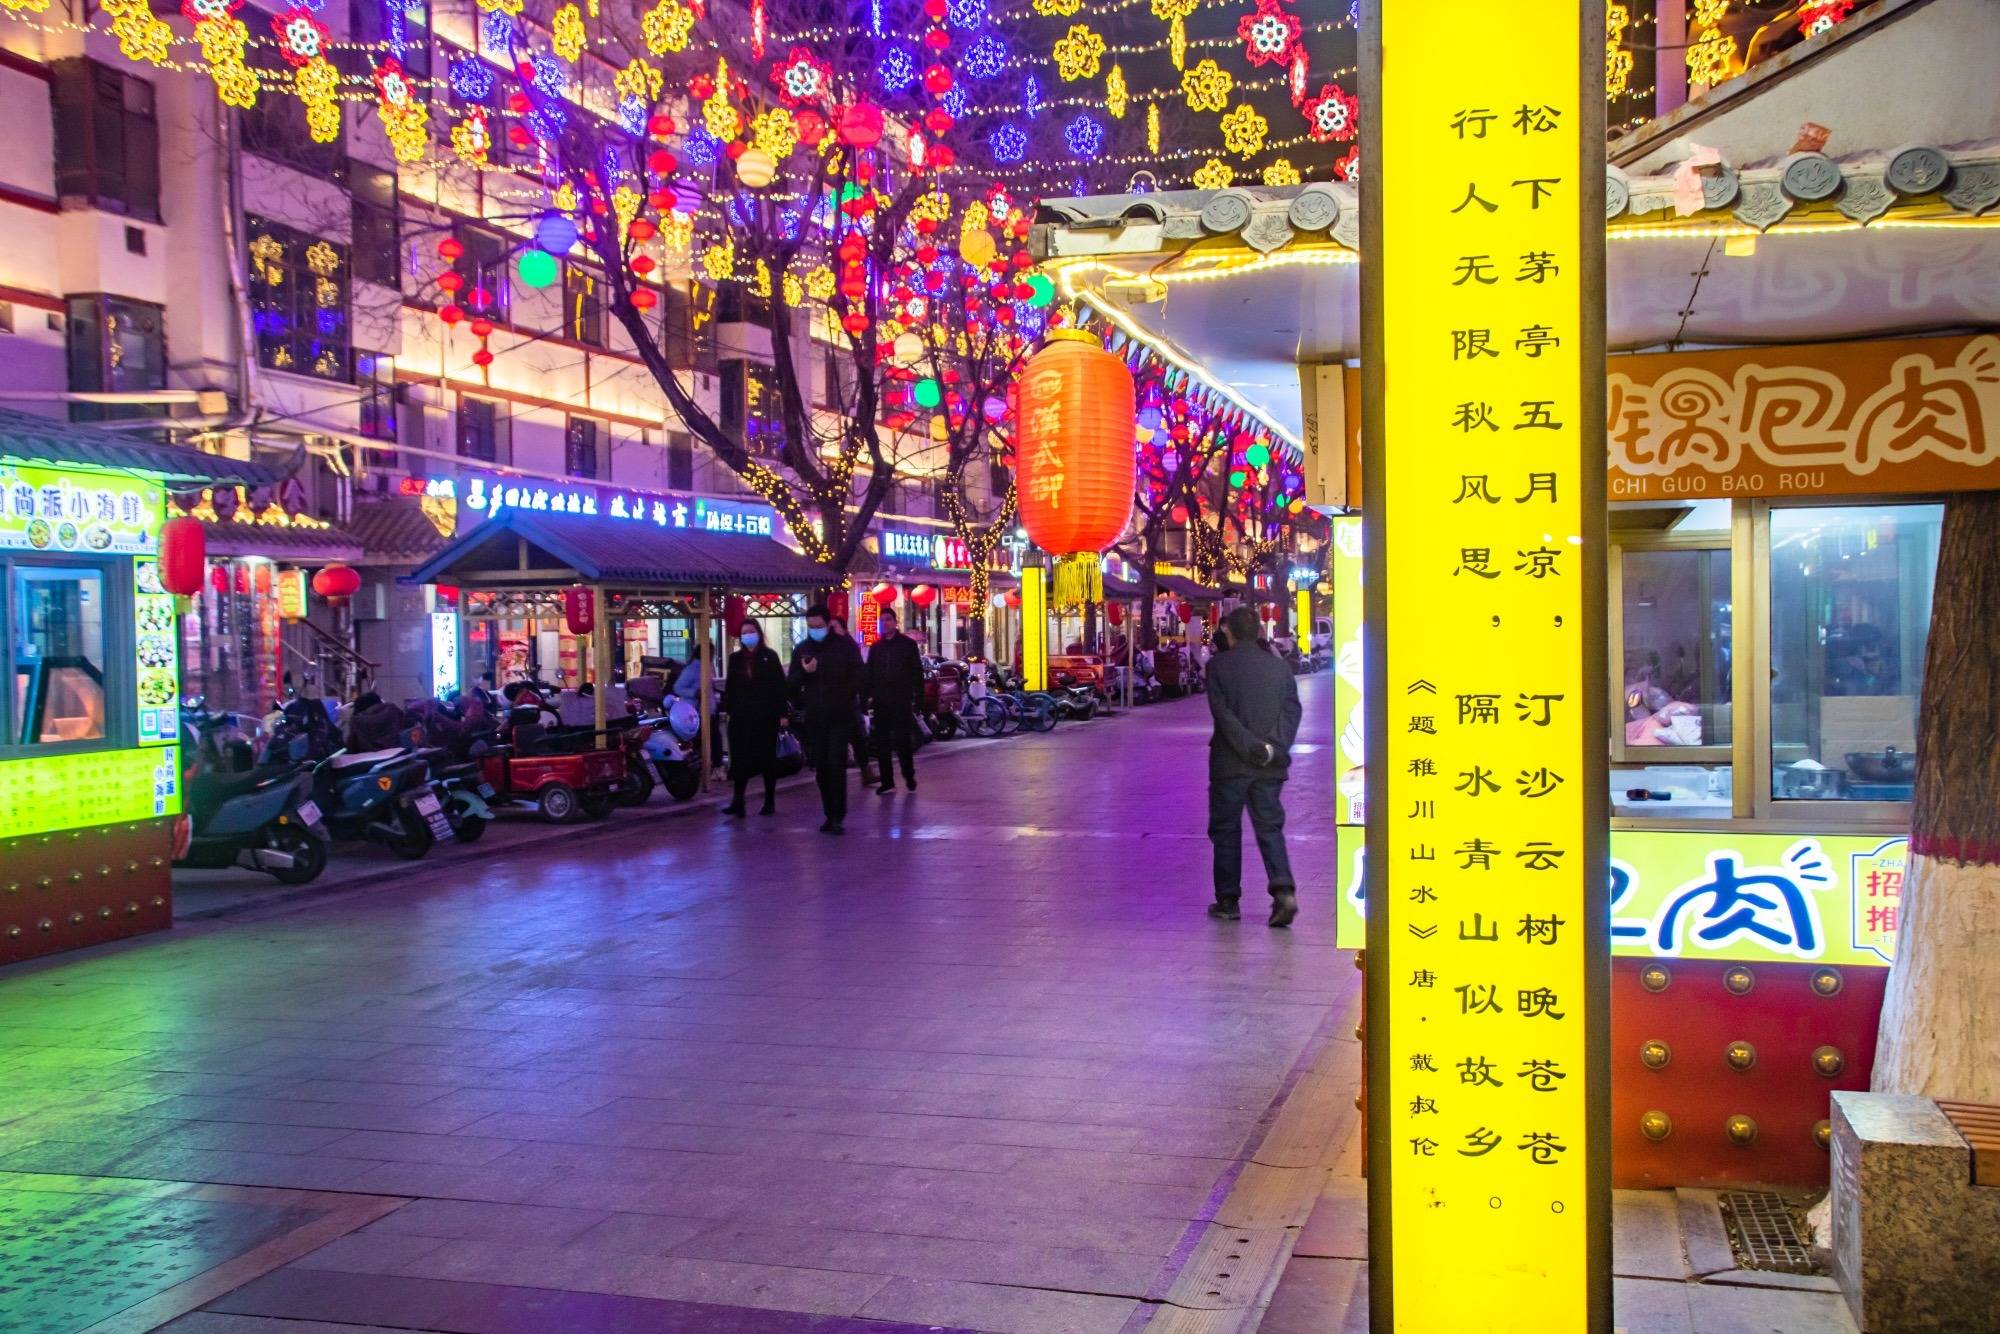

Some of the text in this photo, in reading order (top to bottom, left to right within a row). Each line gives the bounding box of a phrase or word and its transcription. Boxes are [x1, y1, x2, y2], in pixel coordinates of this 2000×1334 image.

[1613, 472, 1824, 494] CHI GUO BAO ROU
